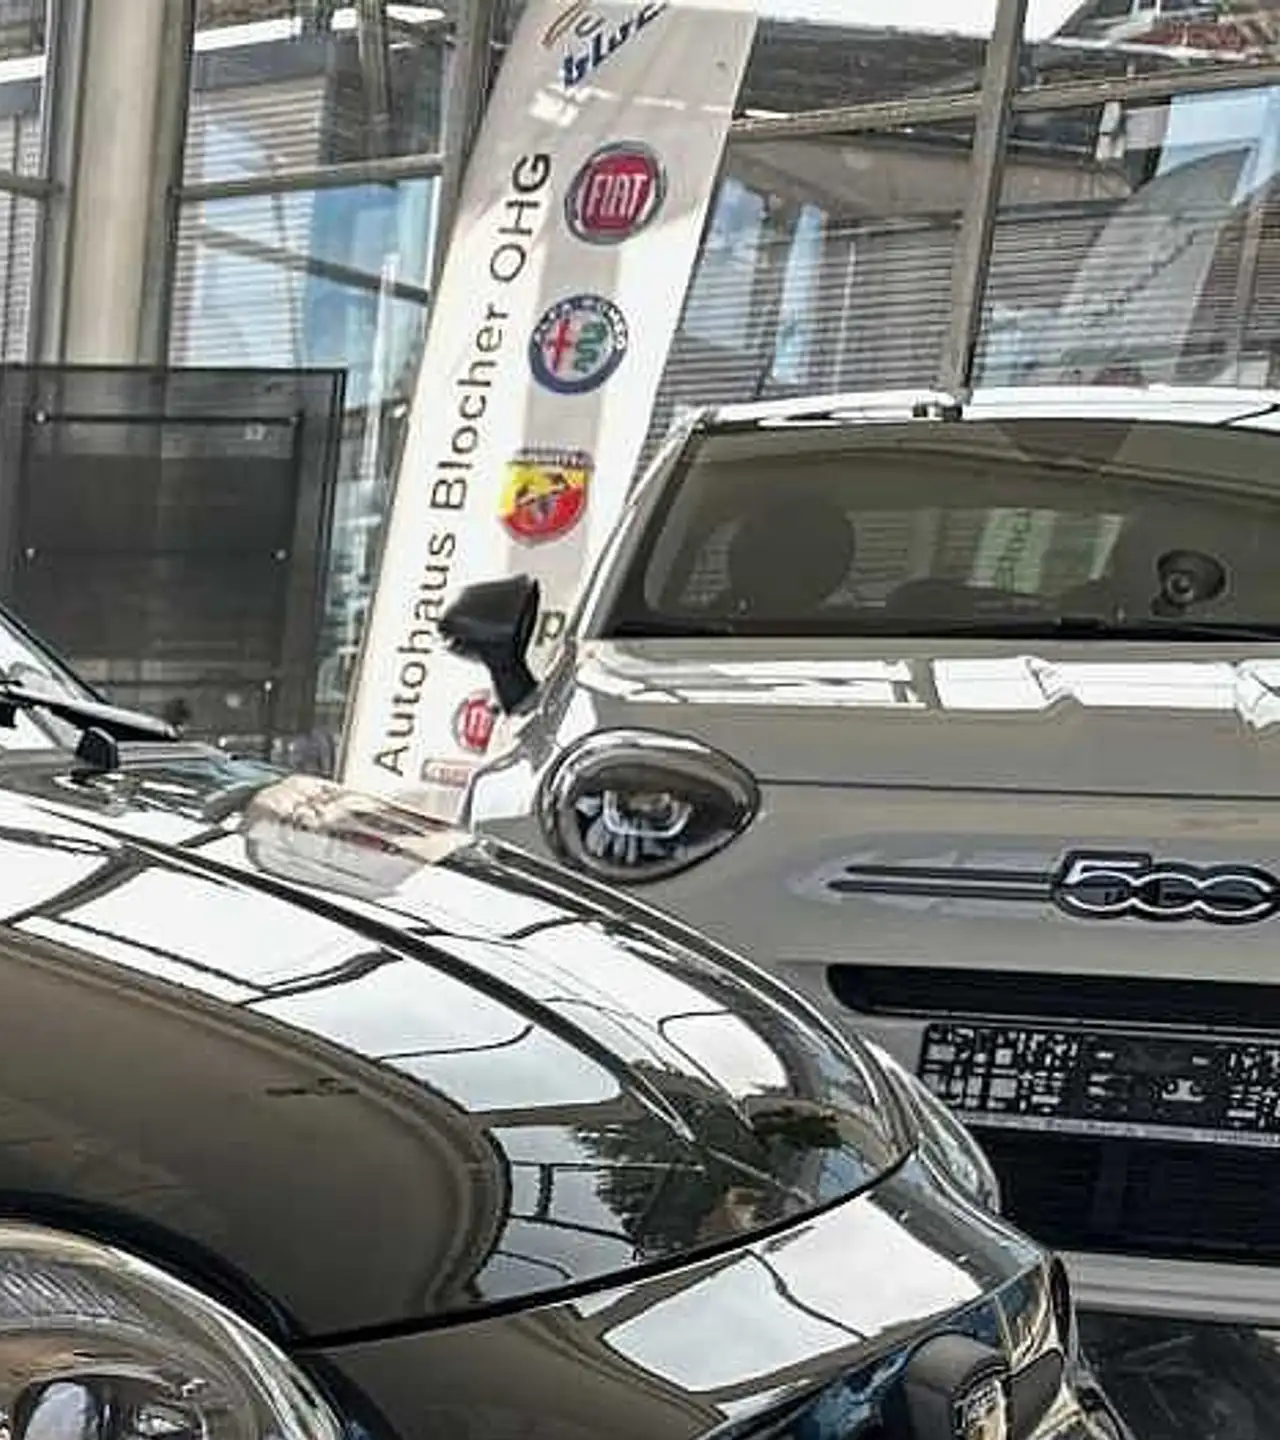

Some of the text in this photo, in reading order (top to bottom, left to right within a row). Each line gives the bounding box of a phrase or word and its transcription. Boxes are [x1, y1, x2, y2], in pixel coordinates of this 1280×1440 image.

[585, 172, 649, 220] FIAT
[373, 535, 457, 776] Autohaus
[430, 303, 509, 513] Blocher
[489, 151, 553, 283] OHG
[1054, 850, 1280, 924] 500
